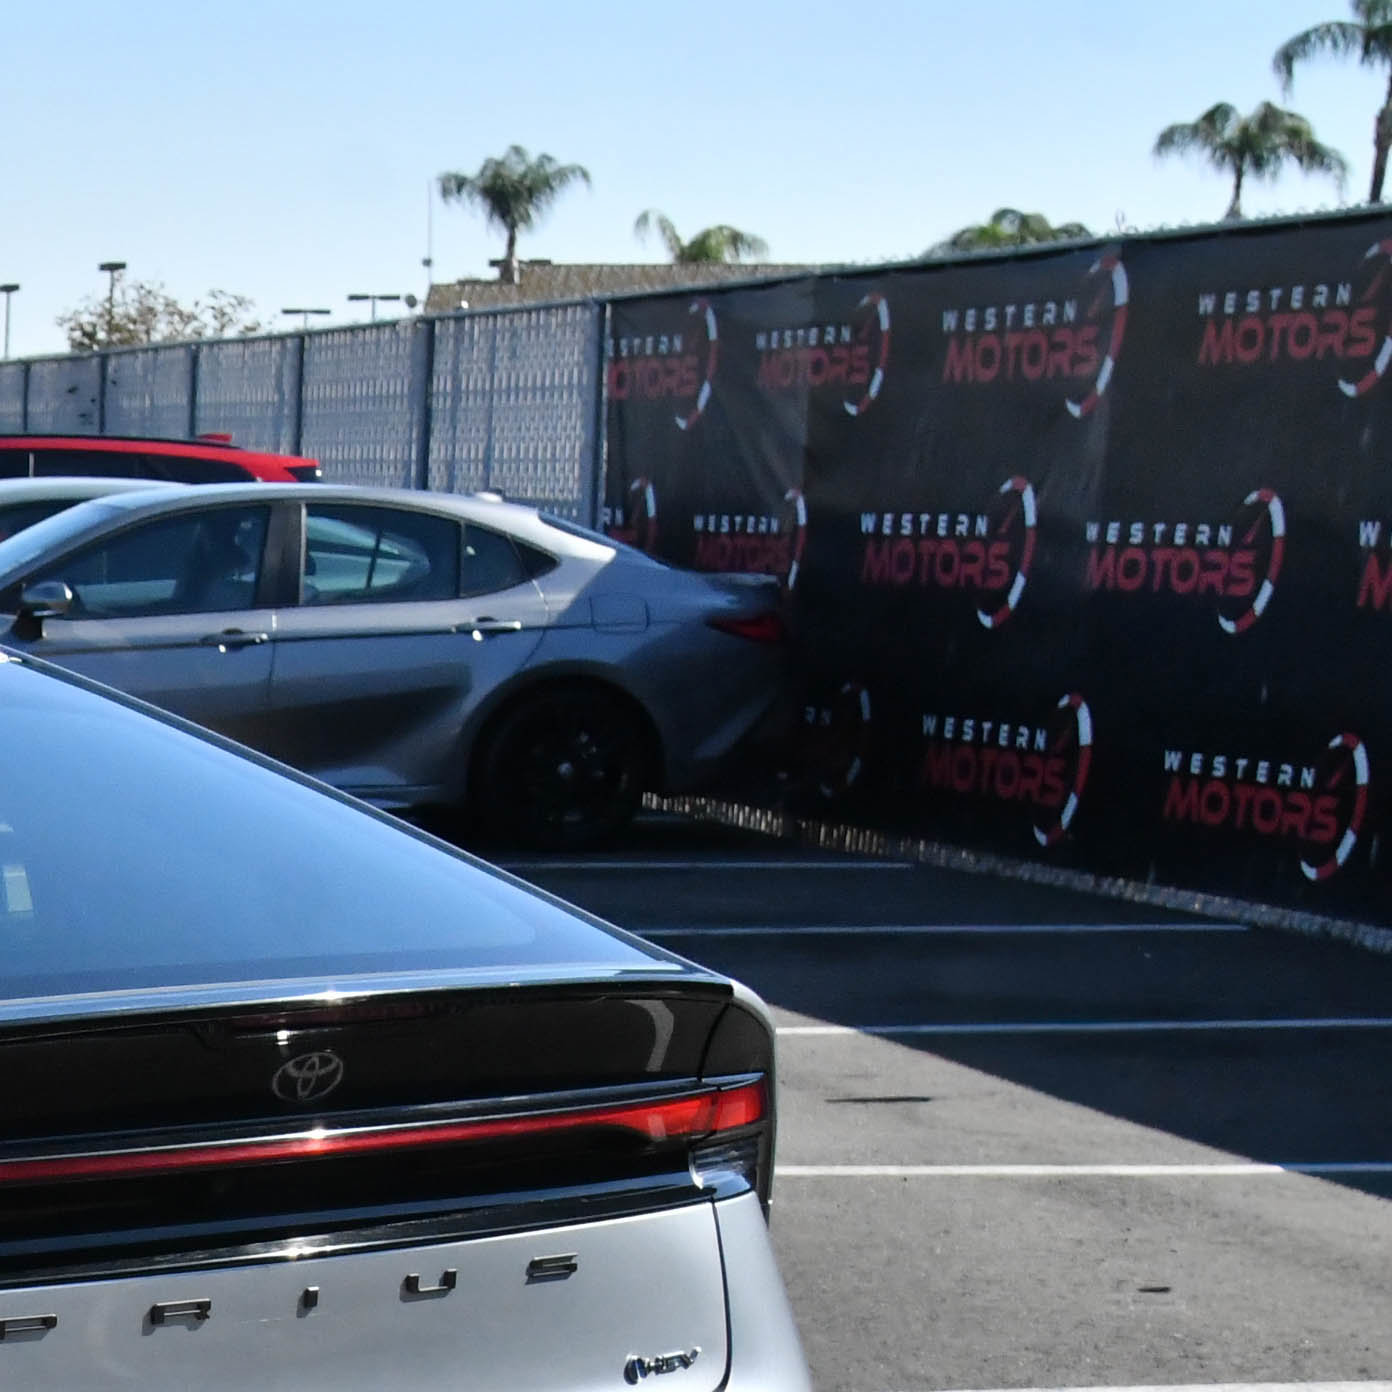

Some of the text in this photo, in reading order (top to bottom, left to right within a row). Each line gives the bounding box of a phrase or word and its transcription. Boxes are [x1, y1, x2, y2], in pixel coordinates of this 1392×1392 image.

[943, 300, 1077, 332] WESTERN
[1198, 282, 1352, 315] WESTERN
[607, 334, 683, 358] ESTERN
[755, 325, 851, 350] WESTERN
[943, 325, 1099, 383] MOTORS
[1198, 307, 1377, 366] MOTORS
[605, 356, 698, 398] OTORS
[693, 514, 778, 533] WESTERN
[860, 512, 988, 536] WESTERN
[1086, 520, 1232, 547] WESTERN
[861, 538, 1010, 590] MOTORS
[1080, 546, 1257, 597] MOTORS
[922, 714, 1048, 751] WESTERN
[924, 743, 1066, 805] MOTORS
[1164, 750, 1315, 788] WESTERN
[1163, 776, 1339, 842] MOTORS
